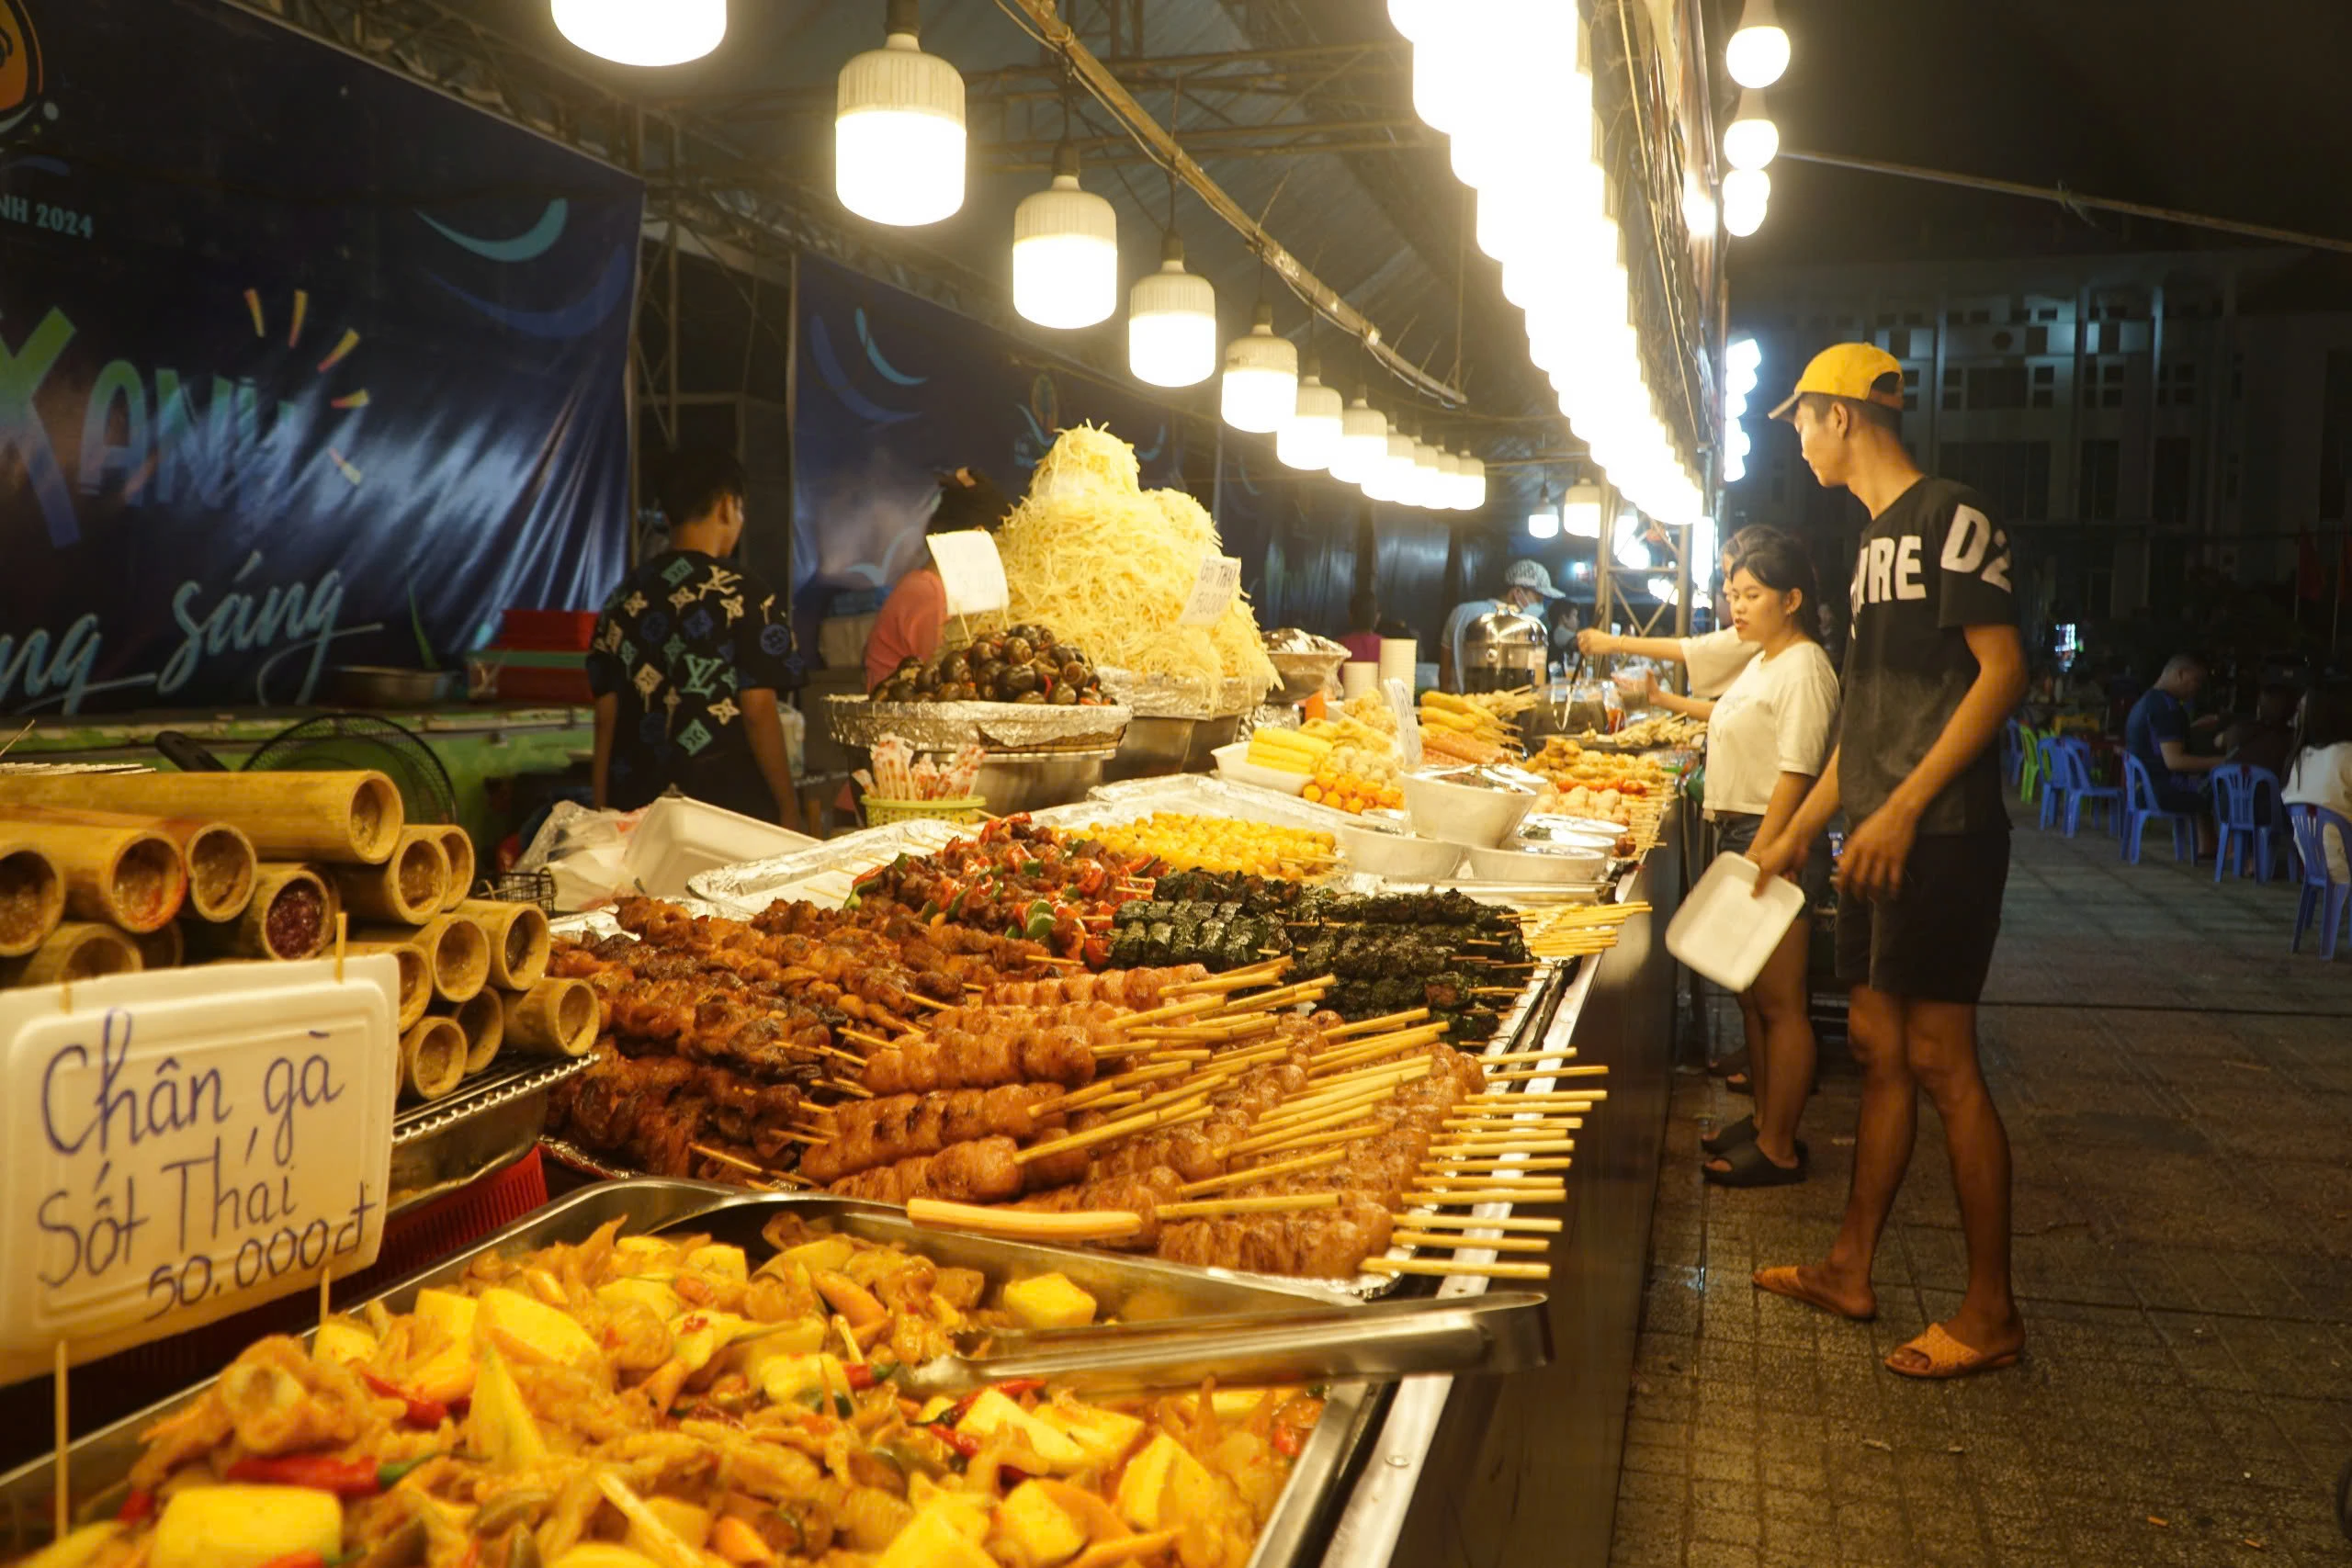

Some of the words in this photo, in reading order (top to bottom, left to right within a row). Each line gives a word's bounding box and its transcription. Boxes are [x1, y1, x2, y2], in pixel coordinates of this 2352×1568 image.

[35, 201, 94, 241] 2024
[40, 1008, 233, 1156] Chân
[263, 1030, 346, 1168] gà
[37, 1160, 150, 1288] Sốt
[160, 1126, 298, 1253] Thái
[143, 1179, 378, 1323] 50.000đ
